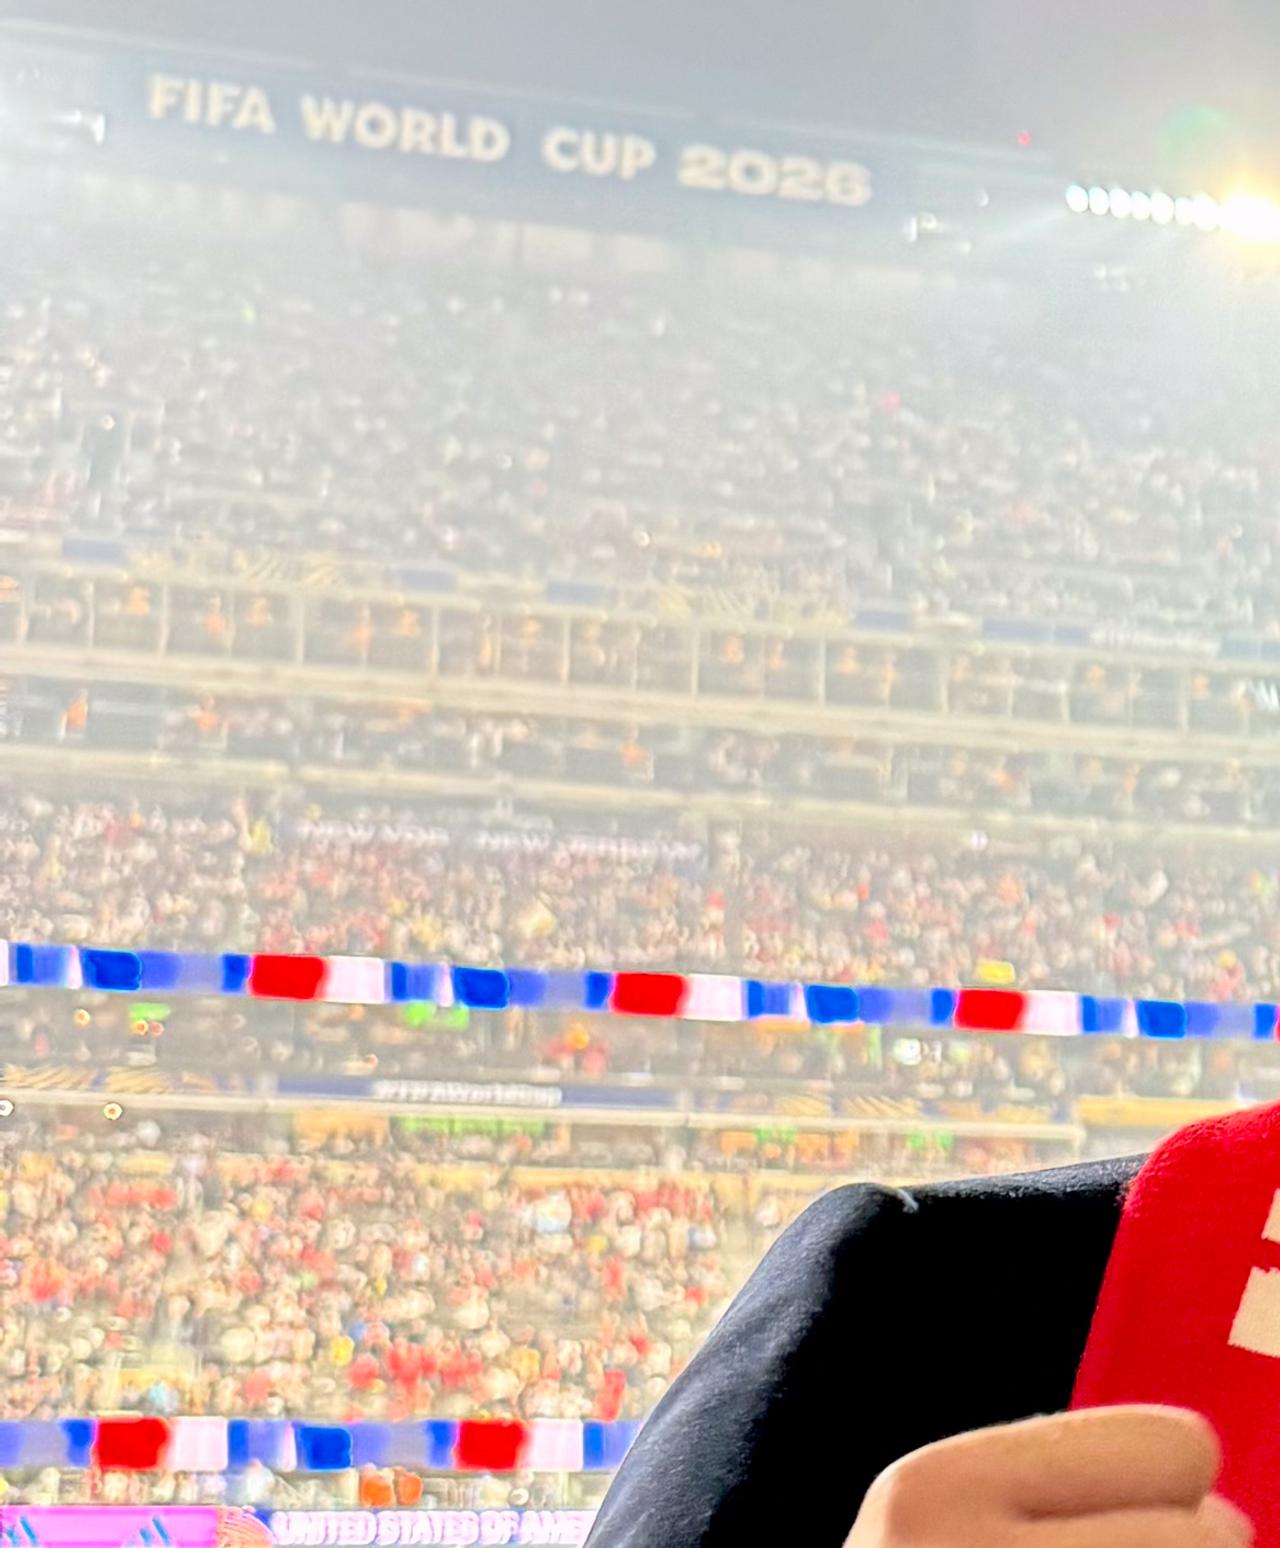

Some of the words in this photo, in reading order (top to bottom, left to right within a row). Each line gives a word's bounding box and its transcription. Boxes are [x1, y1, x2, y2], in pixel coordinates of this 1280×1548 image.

[148, 74, 276, 135] FIFA
[301, 94, 509, 162] WORLD
[542, 126, 656, 181] CUP
[677, 145, 872, 207] 2026
[272, 1511, 376, 1545] UNITED
[376, 1511, 479, 1545] STATES
[480, 1511, 519, 1545] OF
[519, 1511, 597, 1545] AME
